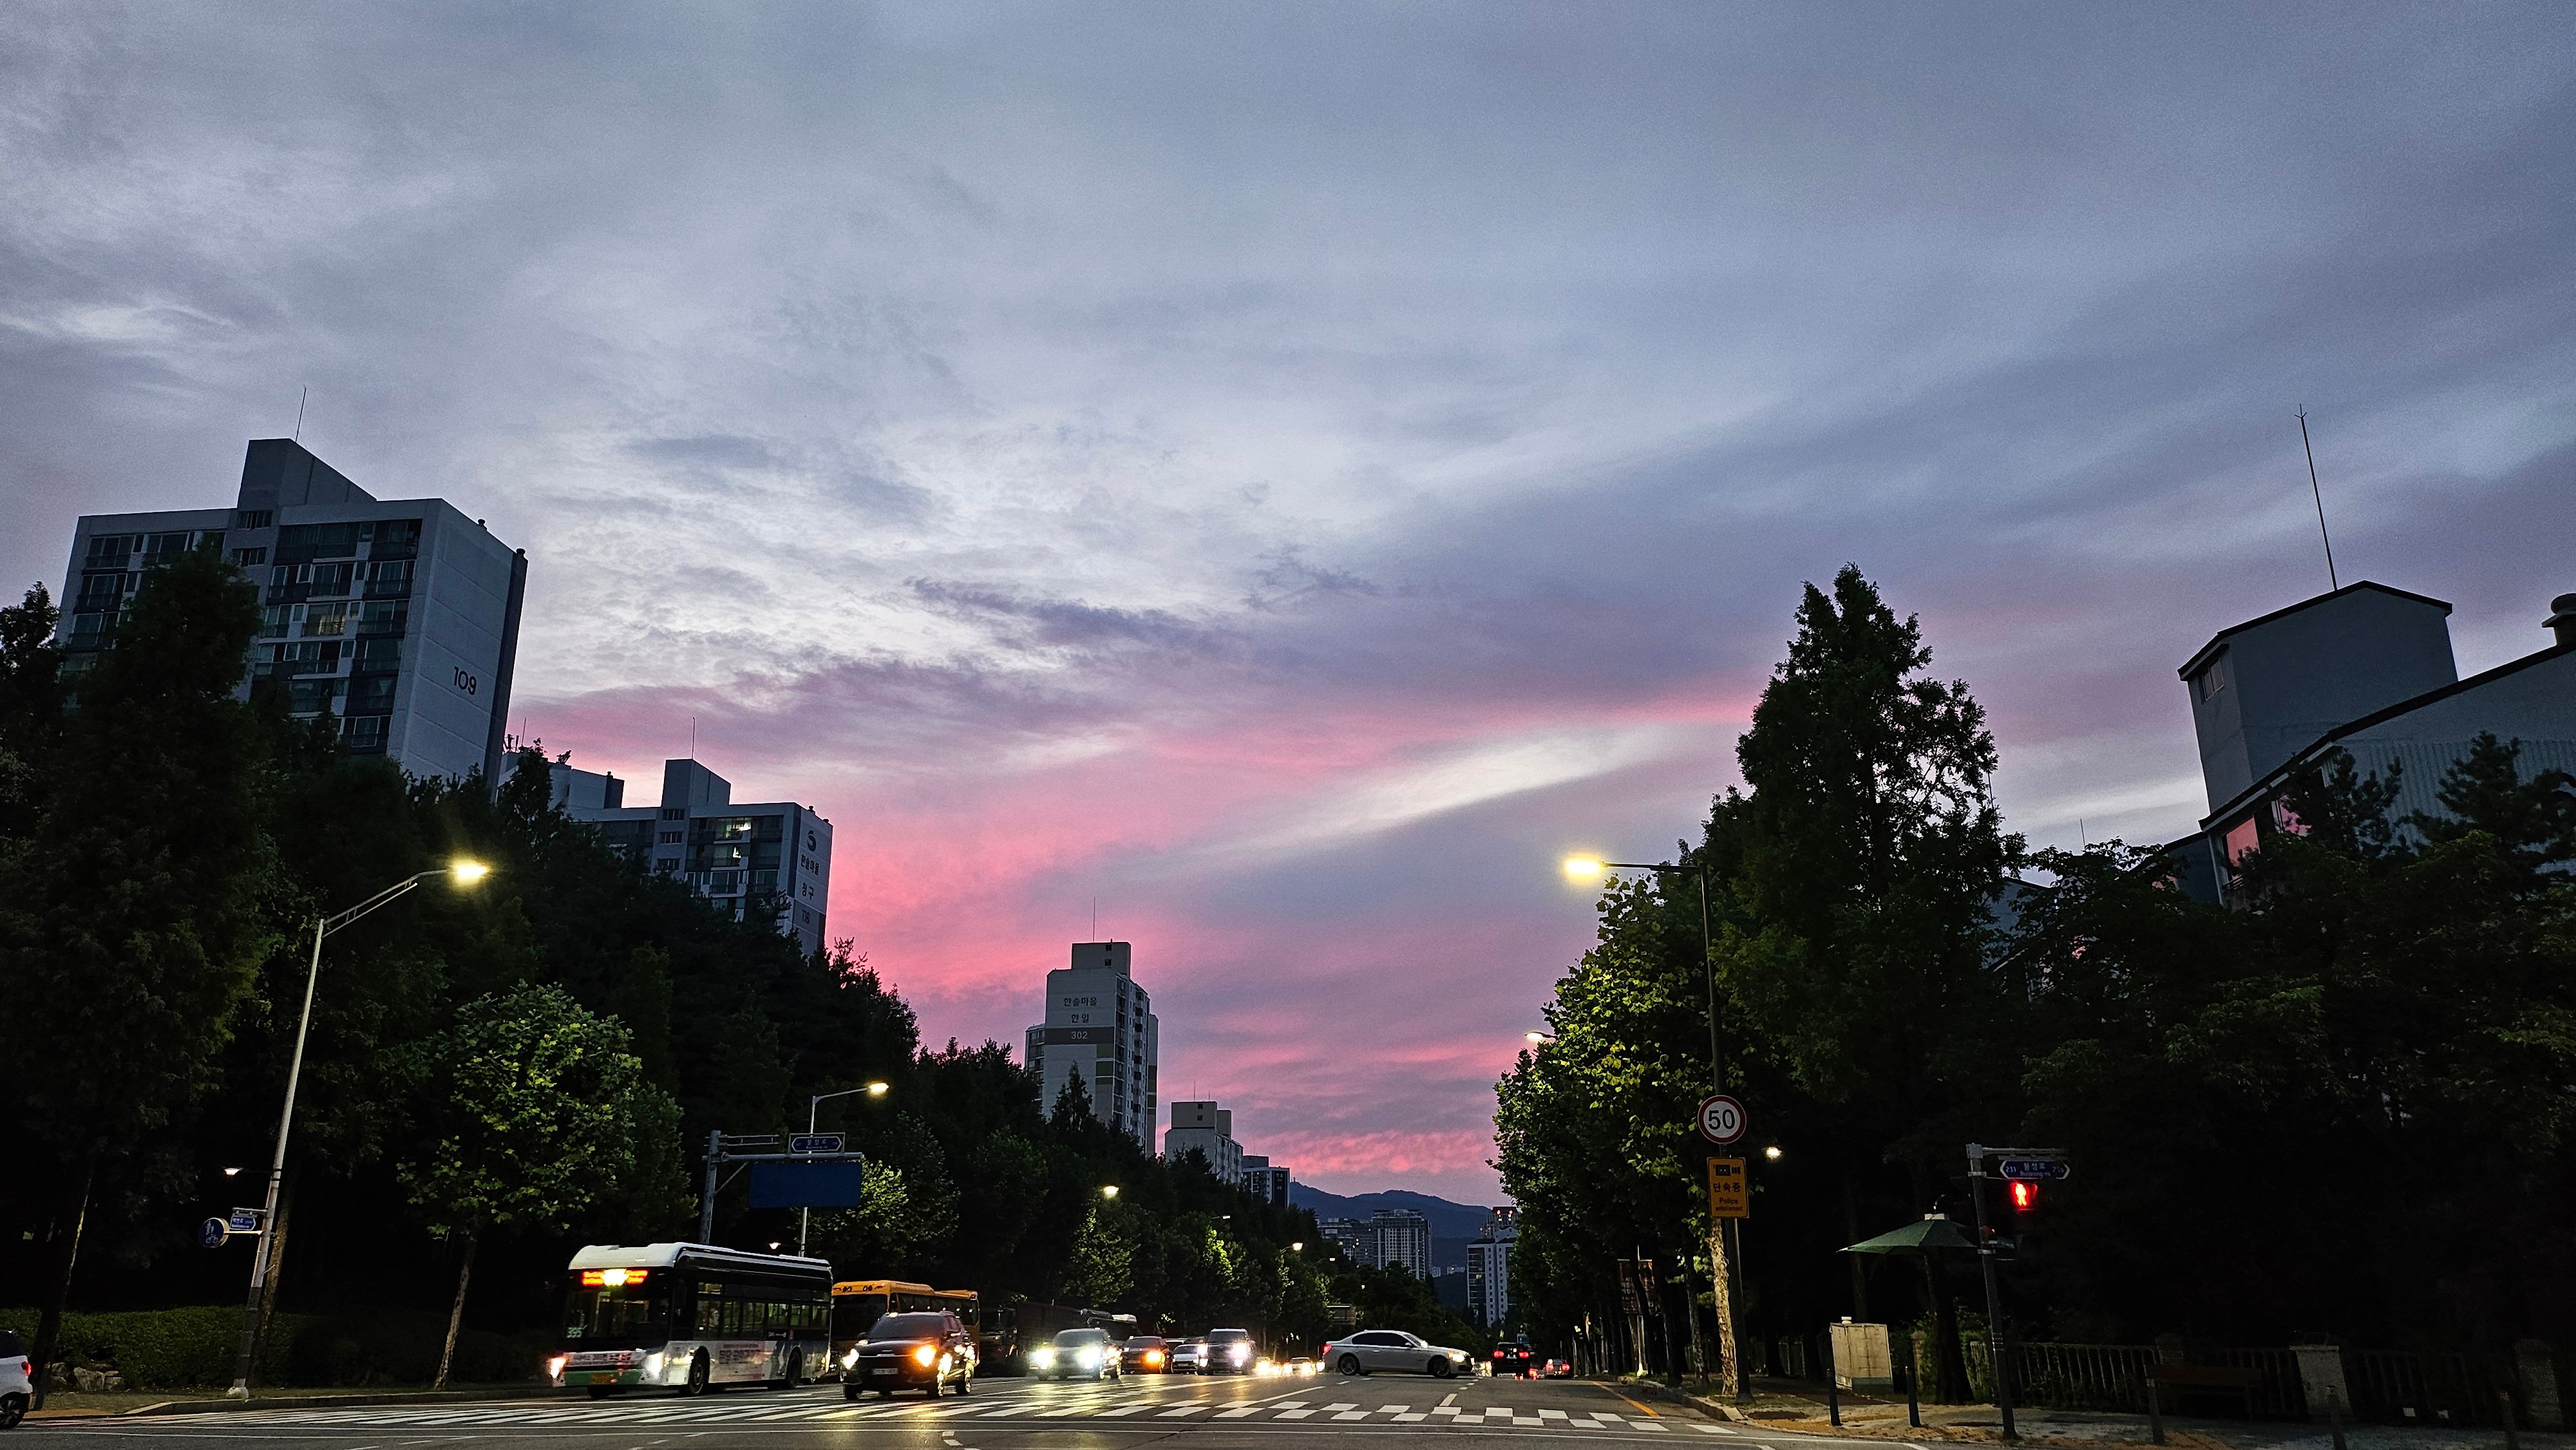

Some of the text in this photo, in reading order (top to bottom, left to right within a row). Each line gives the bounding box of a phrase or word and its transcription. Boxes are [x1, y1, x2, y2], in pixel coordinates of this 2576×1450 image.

[454, 666, 477, 695] 109
[800, 854, 820, 876] 한솔마을
[802, 882, 815, 901] 청구
[1063, 997, 1098, 1007] 한솔마을
[1071, 1031, 1088, 1040] 302
[1708, 1109, 1736, 1131] 50
[1713, 1182, 1741, 1193] 단속중
